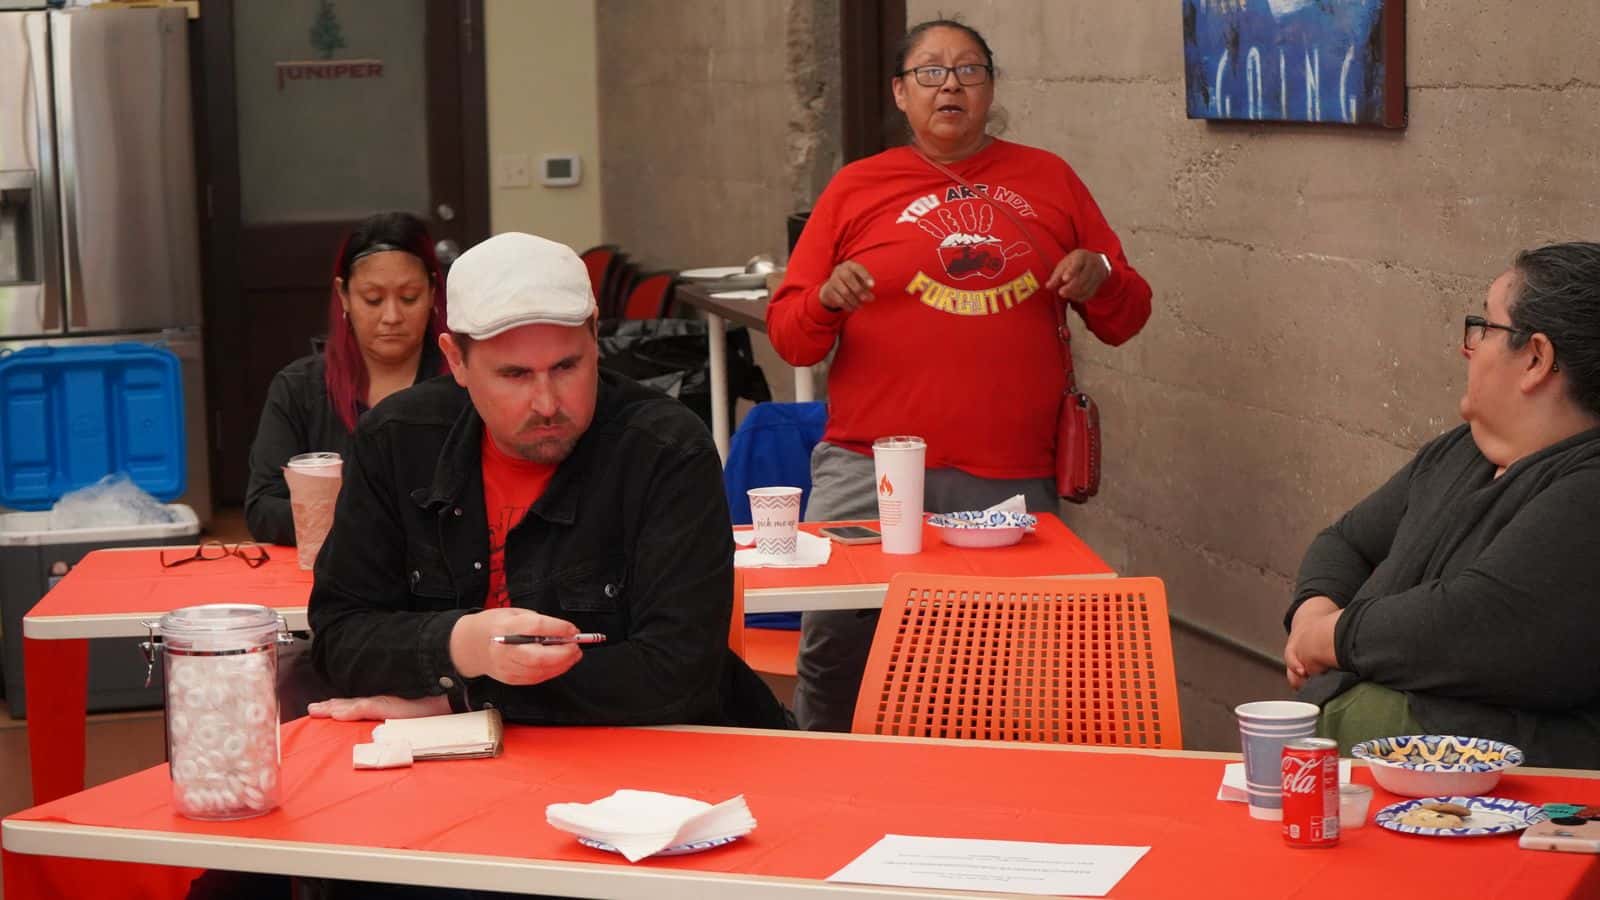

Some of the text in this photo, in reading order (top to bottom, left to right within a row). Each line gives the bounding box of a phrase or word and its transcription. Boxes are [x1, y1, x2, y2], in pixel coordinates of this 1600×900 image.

[275, 60, 384, 91] JUNIPER
[1215, 45, 1357, 123] GOING
[896, 193, 941, 224] YOU
[993, 186, 1037, 217] NOT
[905, 270, 1040, 316] FORGOTTEN
